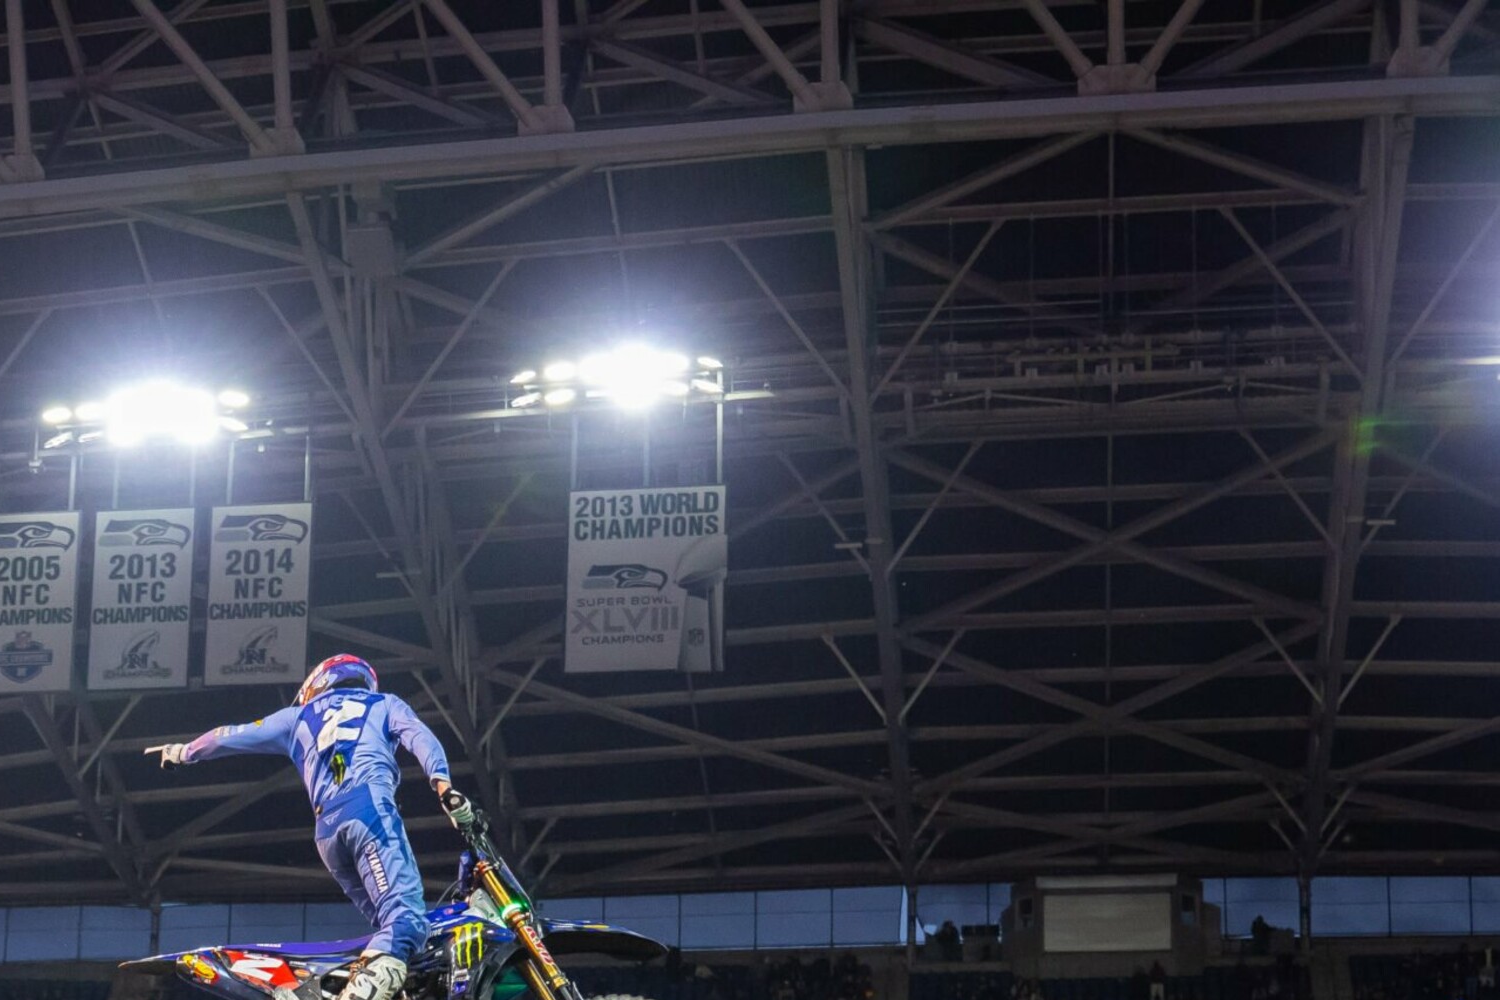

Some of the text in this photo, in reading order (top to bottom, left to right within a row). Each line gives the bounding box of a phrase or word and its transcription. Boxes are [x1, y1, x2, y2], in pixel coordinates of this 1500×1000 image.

[575, 491, 719, 518] 2013 WORLD
[574, 515, 719, 541] CHAMPIONS
[109, 552, 176, 580] 2013
[225, 548, 294, 576] 2014
[2, 583, 50, 606] NFC
[118, 581, 165, 604] NFC
[234, 577, 282, 599] NFC
[209, 600, 306, 620] CHAMPIONS
[577, 595, 673, 608] SUPER BOWL
[93, 604, 188, 625] CHAMPIONS
[571, 606, 679, 634] XLVIII
[582, 634, 665, 646] CHAMPIONS
[317, 700, 367, 753] 2
[367, 851, 390, 895] YAMAHA
